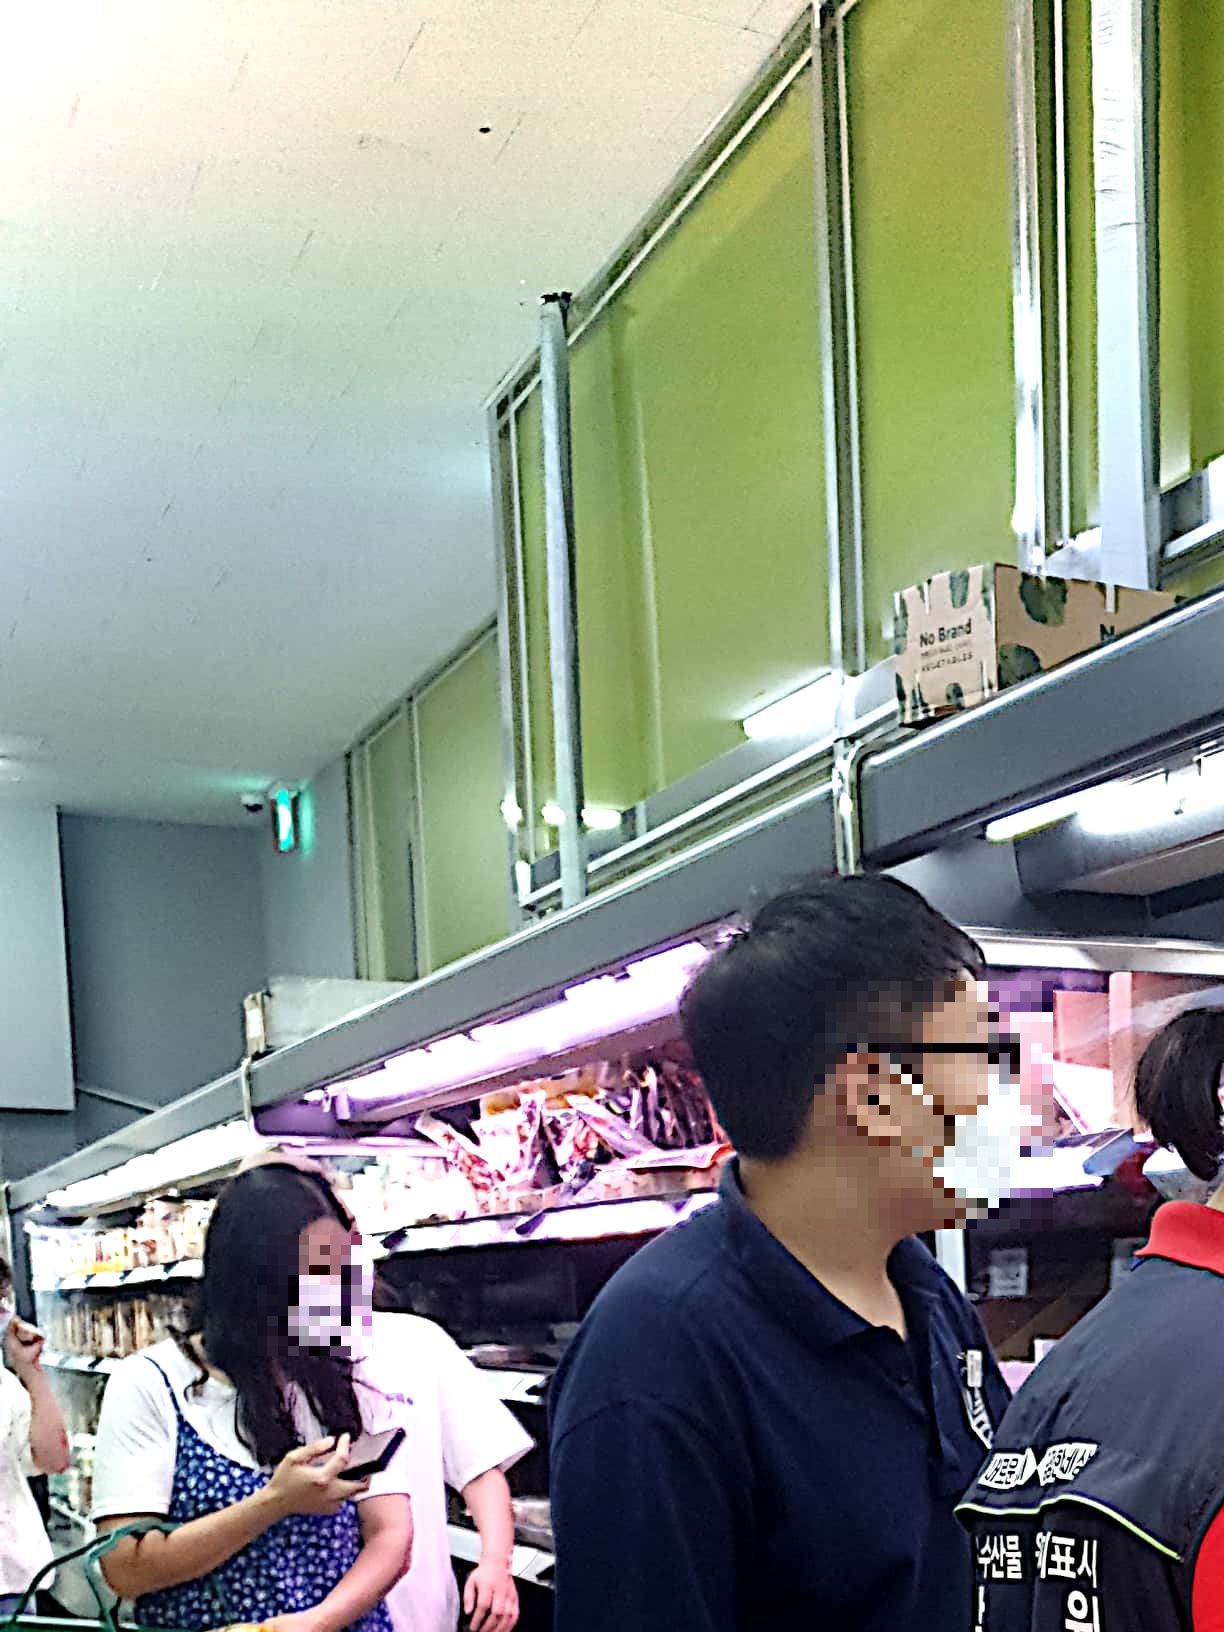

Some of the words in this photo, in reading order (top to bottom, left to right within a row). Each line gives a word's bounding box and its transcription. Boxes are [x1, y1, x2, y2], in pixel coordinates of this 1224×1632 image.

[919, 632, 935, 648] No
[938, 616, 972, 642] Brand
[976, 1535, 1023, 1579] 수산물
